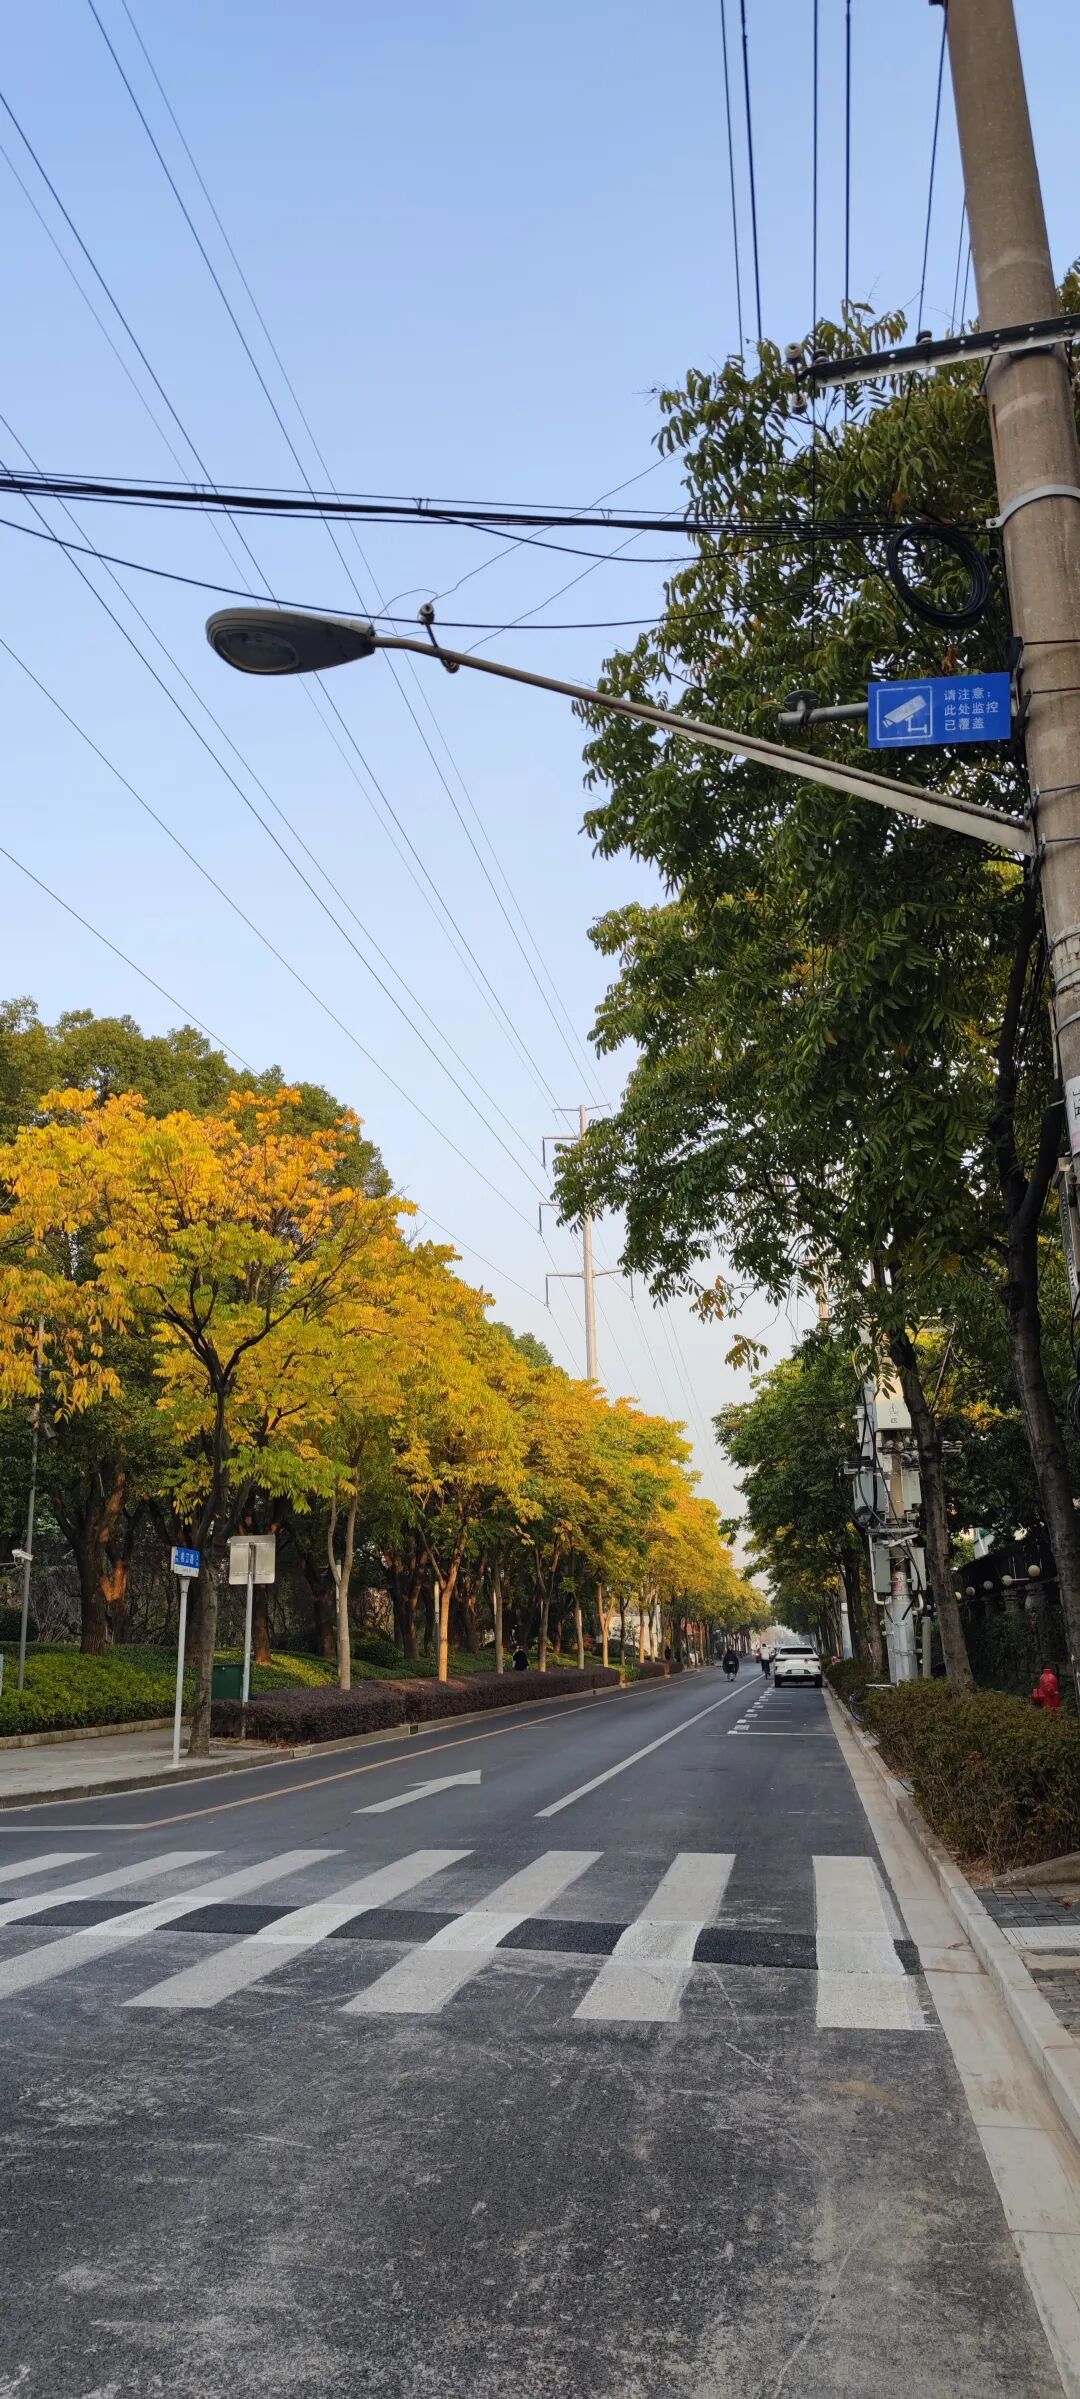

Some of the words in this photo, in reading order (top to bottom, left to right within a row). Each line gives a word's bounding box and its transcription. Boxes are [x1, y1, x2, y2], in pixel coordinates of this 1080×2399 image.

[944, 687, 991, 701] 请注意：
[944, 701, 999, 716] 此处监控
[944, 717, 985, 731] 已覆盖
